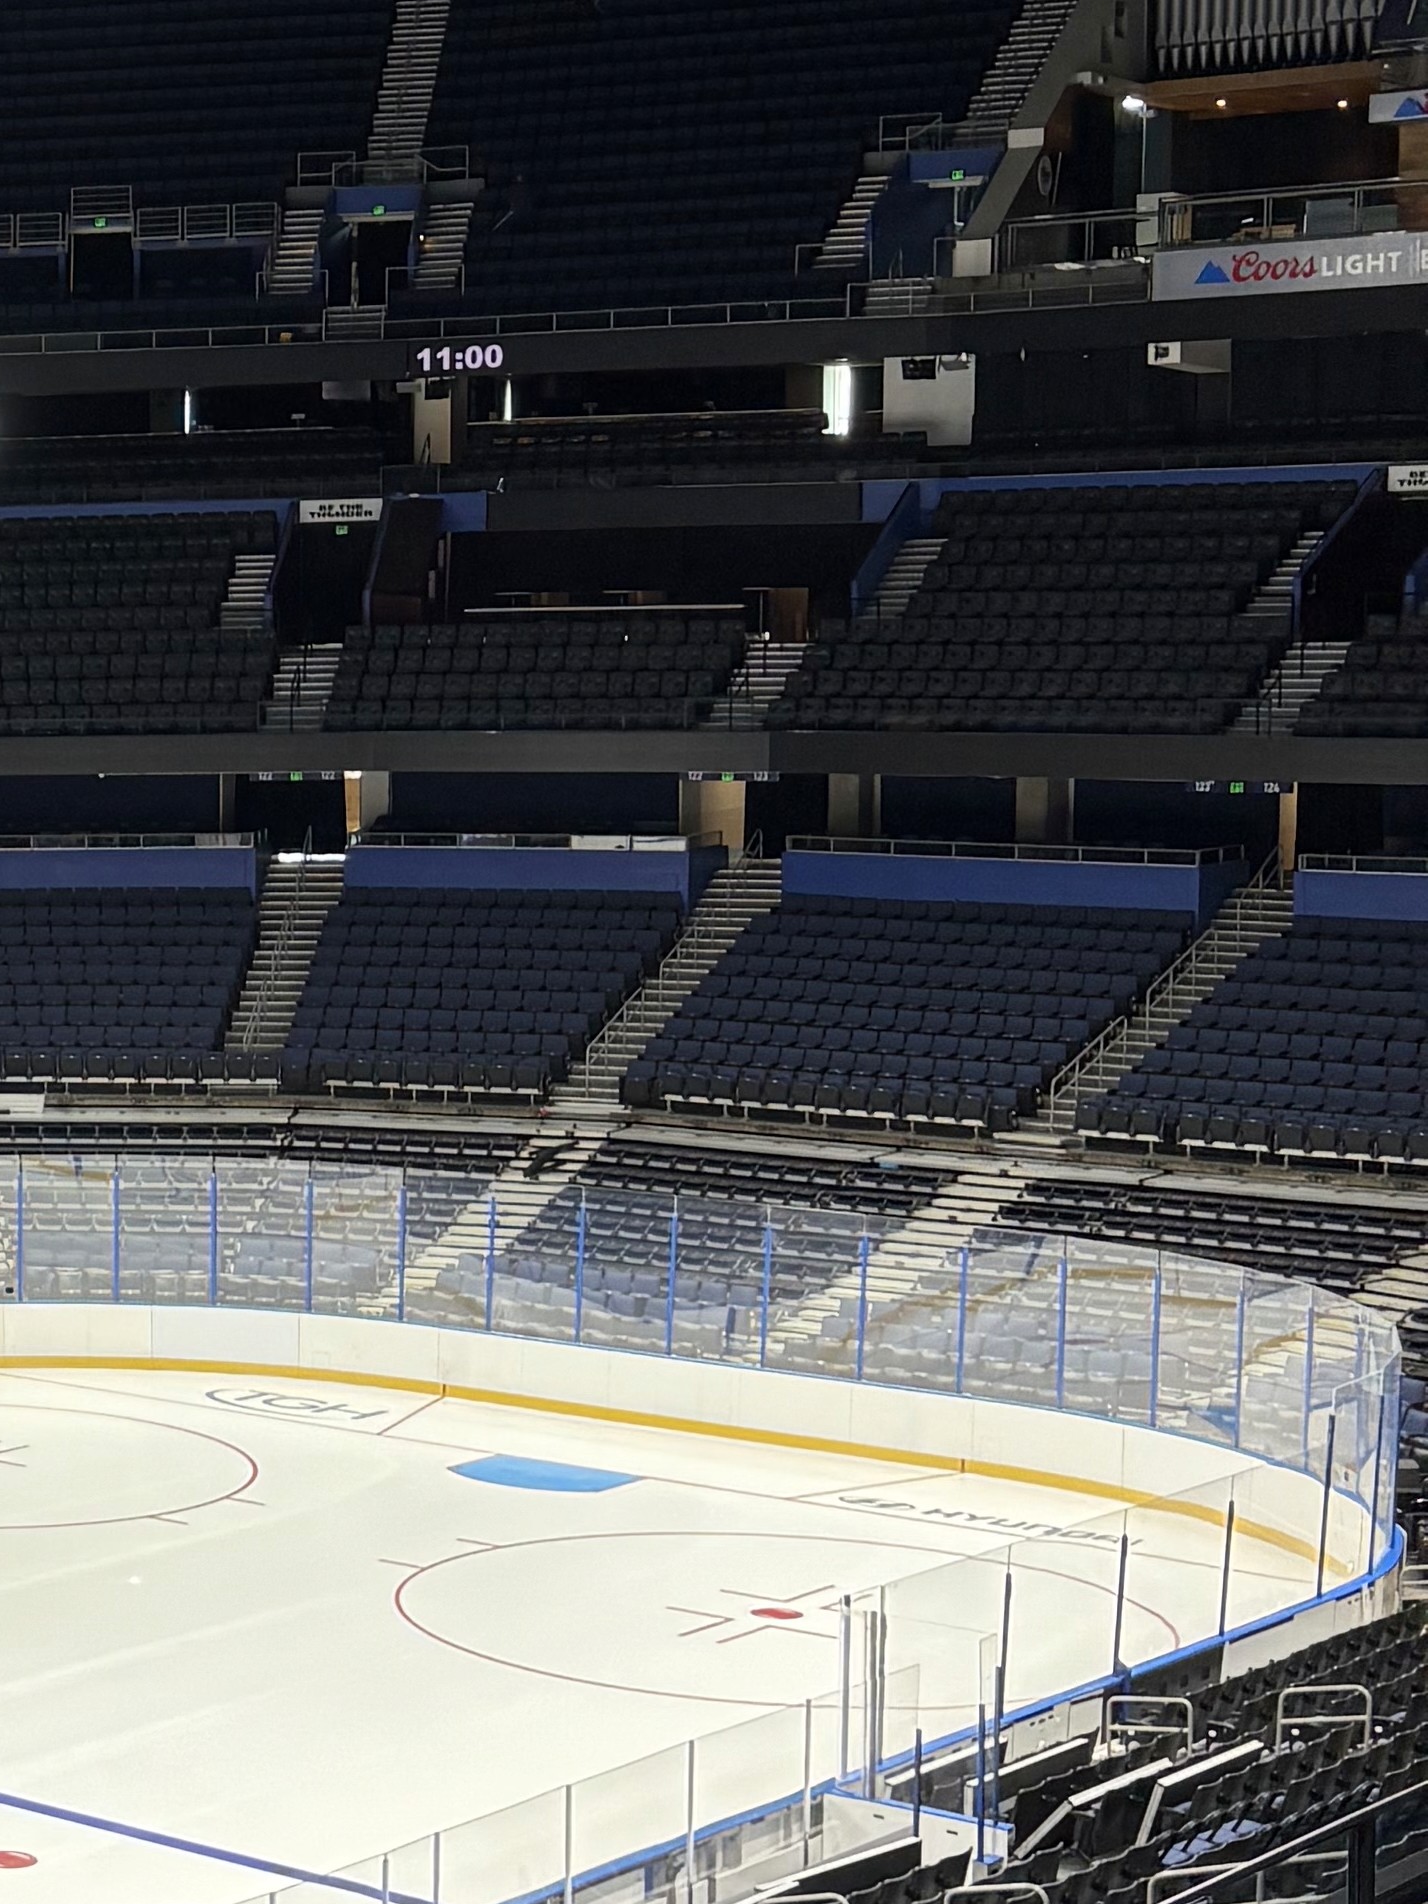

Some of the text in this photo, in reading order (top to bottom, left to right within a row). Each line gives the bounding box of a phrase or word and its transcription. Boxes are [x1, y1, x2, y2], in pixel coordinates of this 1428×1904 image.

[1231, 250, 1319, 283] Coors
[1320, 250, 1403, 278] LIGHT
[416, 344, 504, 372] 11:00
[233, 1389, 390, 1420] TGH
